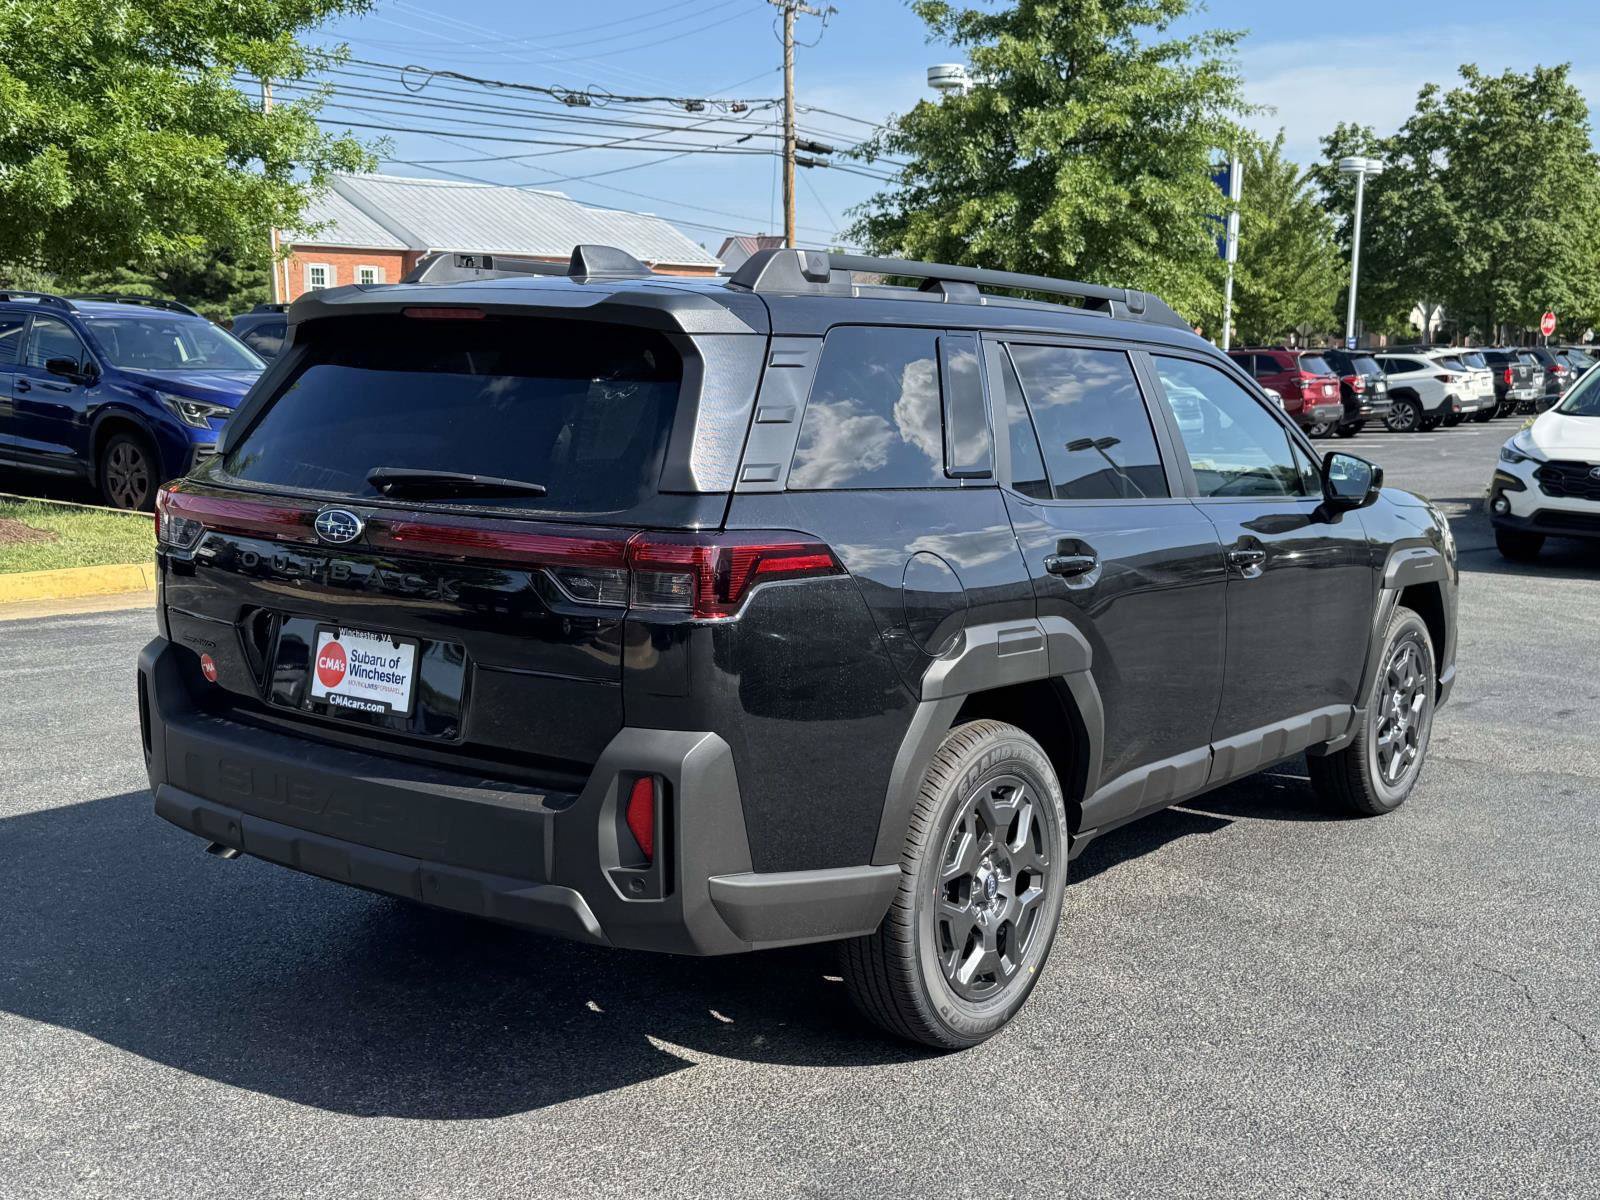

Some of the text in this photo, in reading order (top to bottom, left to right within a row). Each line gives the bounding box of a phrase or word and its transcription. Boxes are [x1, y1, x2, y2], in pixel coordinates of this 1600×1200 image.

[241, 550, 460, 602] OUTBACK
[318, 657, 346, 672] CMA's
[351, 649, 402, 669] Subaru of
[349, 663, 407, 686] Winchester
[329, 694, 385, 713] CMAcars.com
